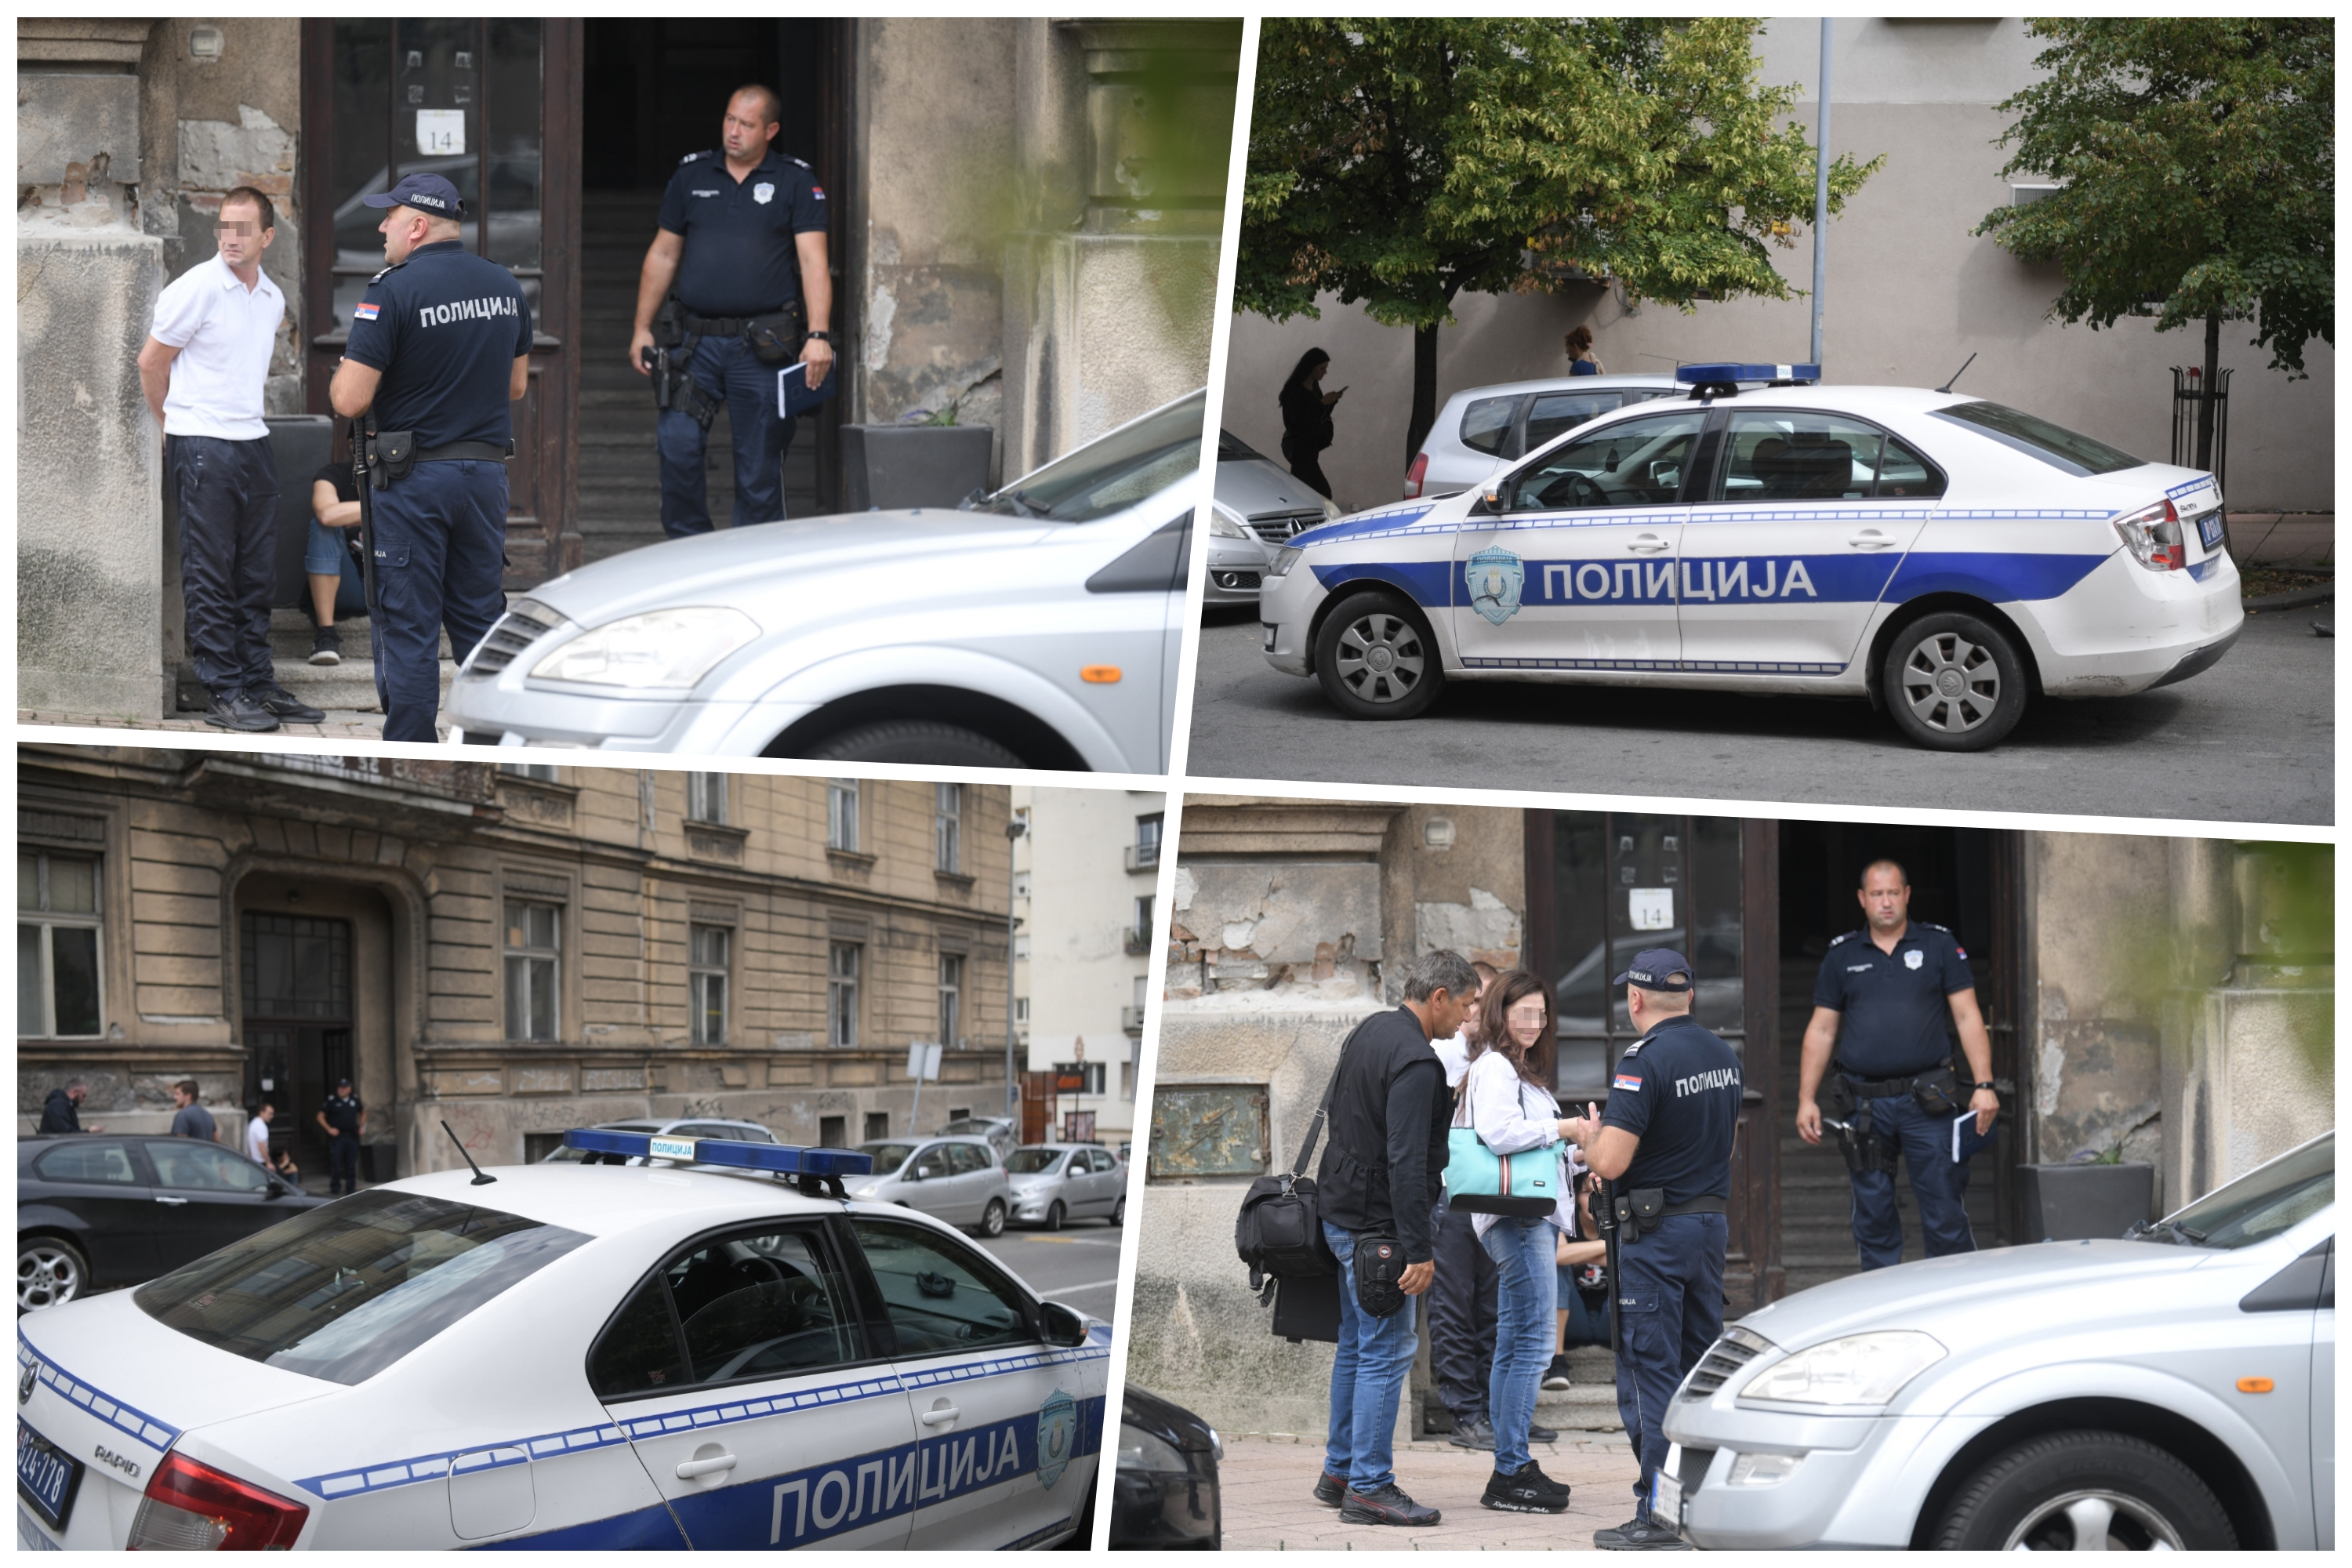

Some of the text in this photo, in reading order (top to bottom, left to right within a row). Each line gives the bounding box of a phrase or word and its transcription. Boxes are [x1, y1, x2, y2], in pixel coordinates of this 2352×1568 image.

[430, 131, 453, 150] 14
[411, 194, 445, 209] ПОЛИЦИЈА
[419, 296, 518, 328] ПОЛИЦИЈА
[1543, 561, 1817, 601] ПОЛИЦИЈА
[1642, 909, 1661, 924] 14
[652, 1142, 692, 1156] ПОЛИЦИЈА
[94, 1444, 141, 1478] RAPID
[770, 1425, 1019, 1544] ПОЛИЦИЈА
